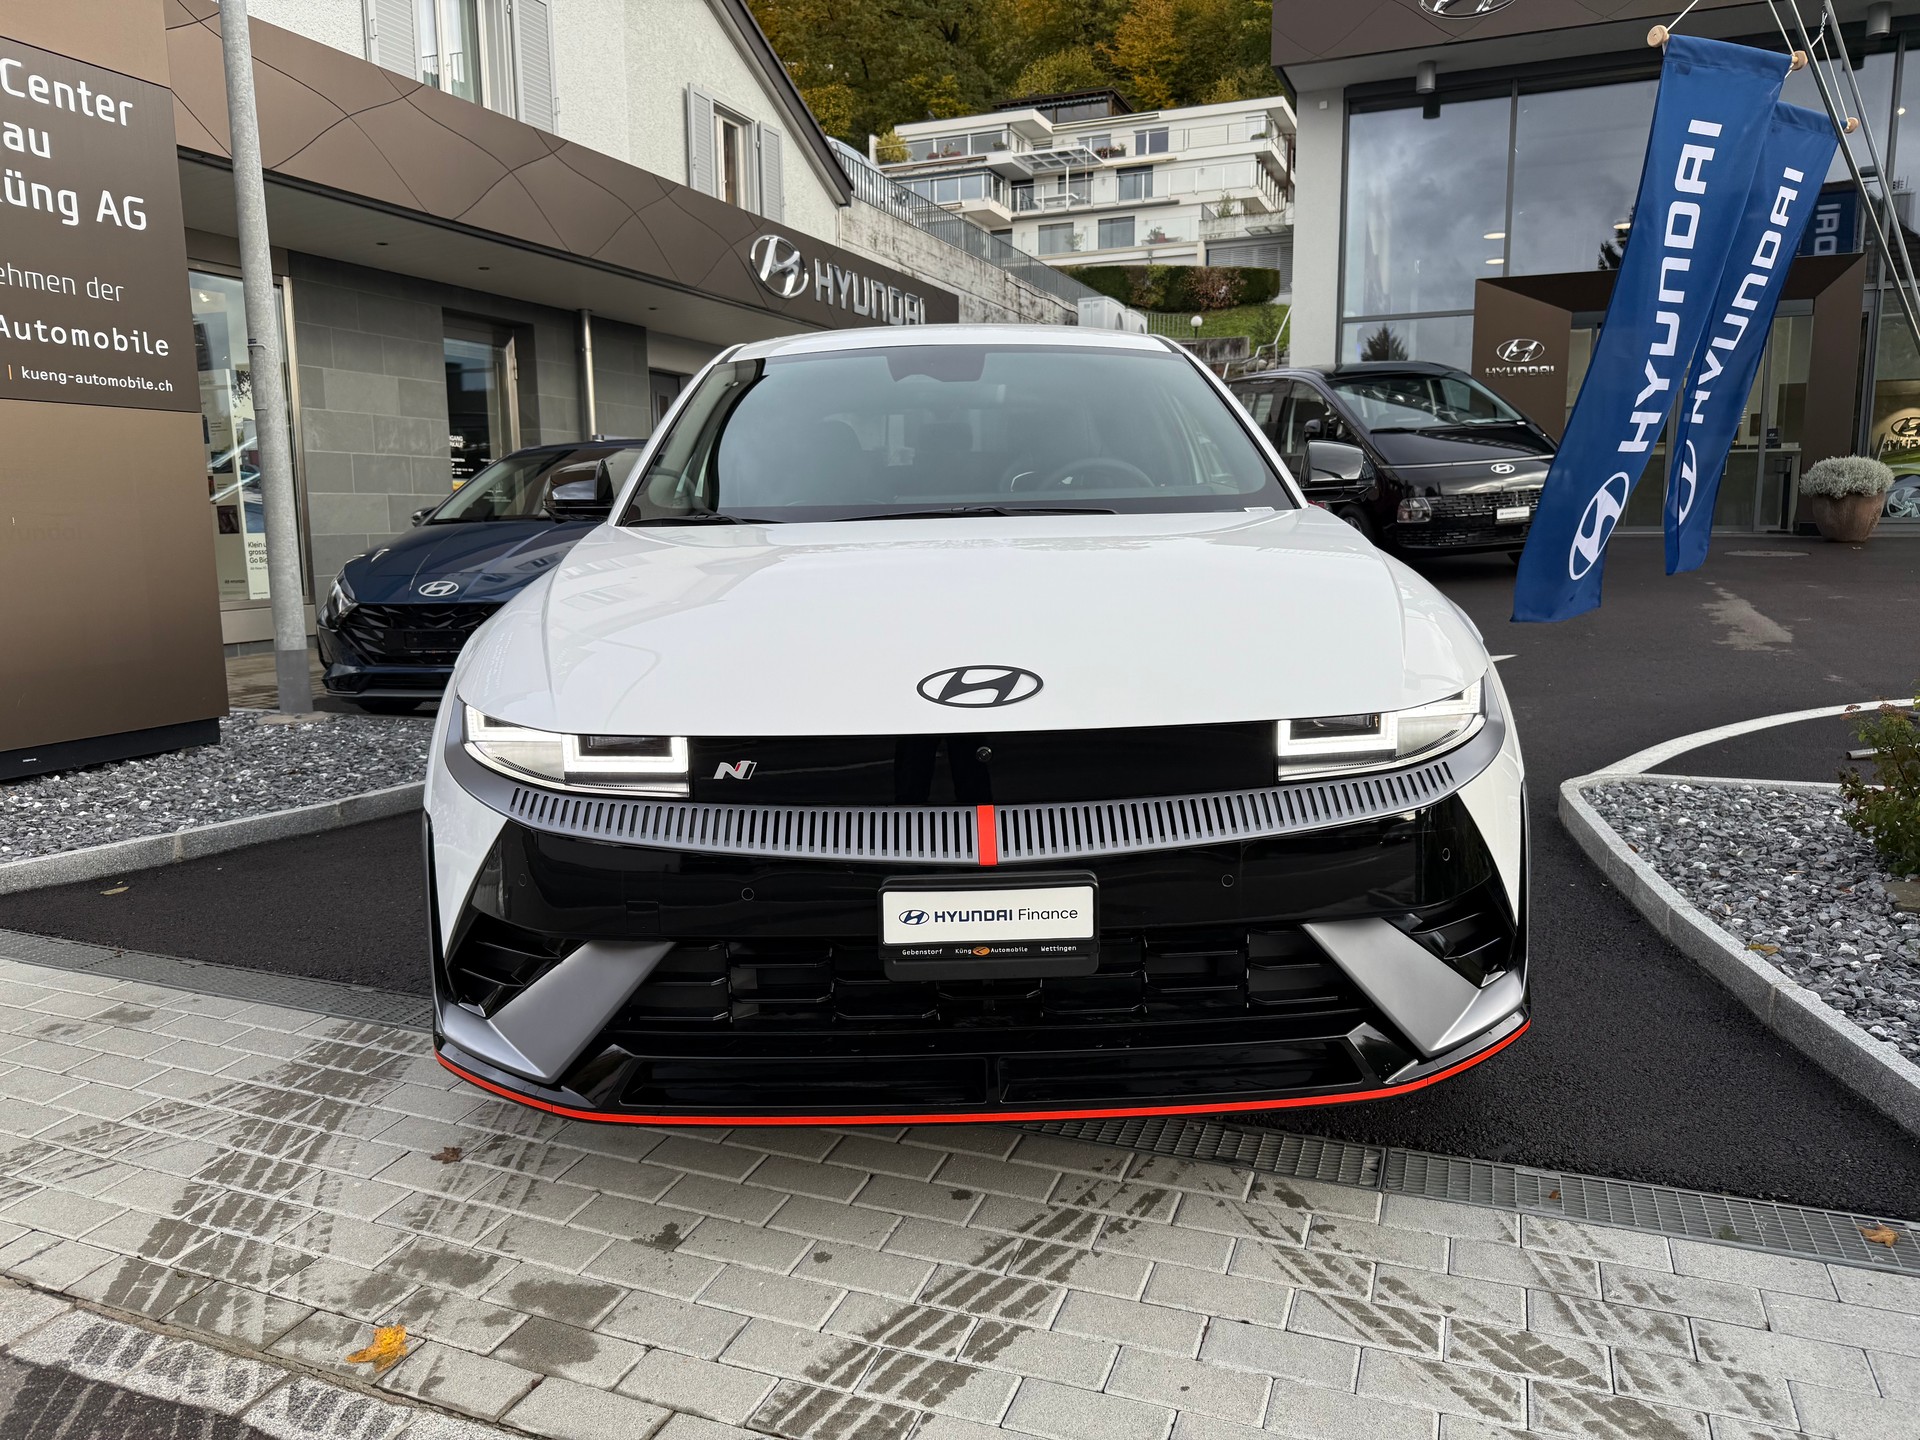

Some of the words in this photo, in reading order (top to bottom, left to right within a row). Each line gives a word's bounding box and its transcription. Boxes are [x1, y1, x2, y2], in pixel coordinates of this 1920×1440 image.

[0, 57, 133, 126] Center
[0, 168, 79, 226] üng
[96, 190, 148, 231] AG
[86, 276, 124, 302] der
[814, 258, 926, 325] HYUNDAI
[1618, 119, 1723, 453] HYUNDAI
[1689, 166, 1804, 424] HYUNDAI
[21, 365, 173, 392] kueng-automobile.ch
[1485, 365, 1555, 376] HYUNDAI
[934, 909, 1013, 922] HYUNDAI
[1018, 908, 1078, 921] Finance
[1040, 945, 1077, 953] Wettingen
